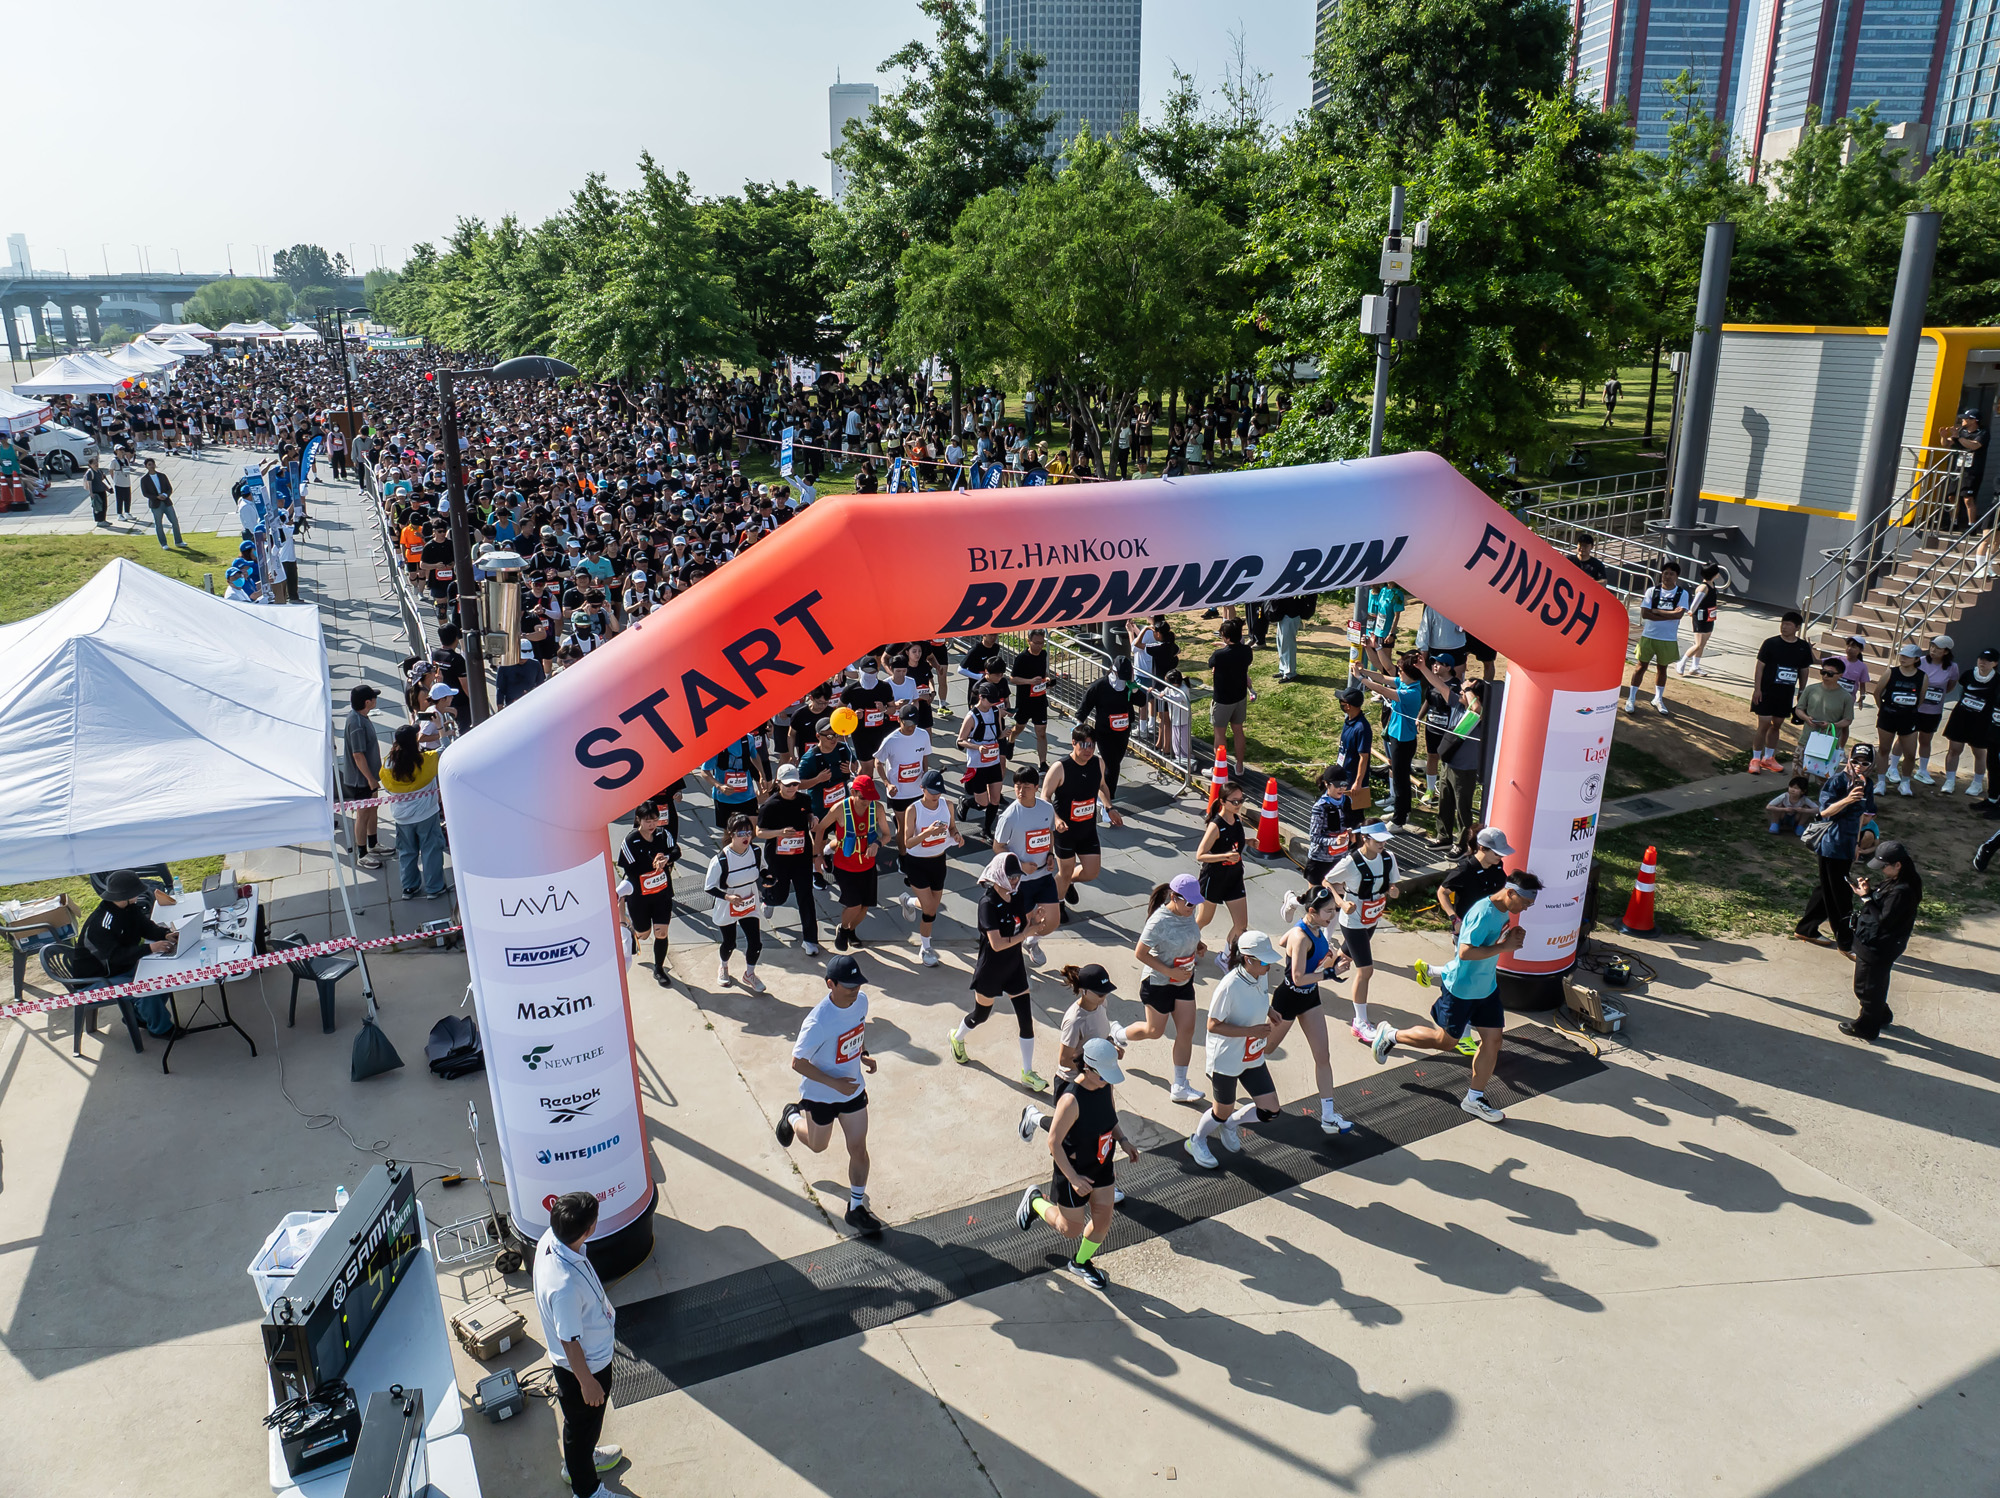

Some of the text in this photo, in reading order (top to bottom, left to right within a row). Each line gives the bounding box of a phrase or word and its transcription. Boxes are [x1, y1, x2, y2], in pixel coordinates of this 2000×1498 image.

[936, 536, 1409, 634] BURNING RUN
[1463, 522, 1600, 646] FINISH
[574, 589, 835, 790] START
[1570, 826, 1594, 841] KIND
[1571, 850, 1589, 862] TOUS
[1566, 865, 1588, 880] JOURS
[512, 942, 579, 962] FAVONEX
[517, 995, 593, 1020] Maxim
[545, 1046, 605, 1070] NEWTREE
[540, 1088, 601, 1109] Reebok
[391, 1203, 411, 1237] 10km
[346, 1199, 397, 1288] SAMIK
